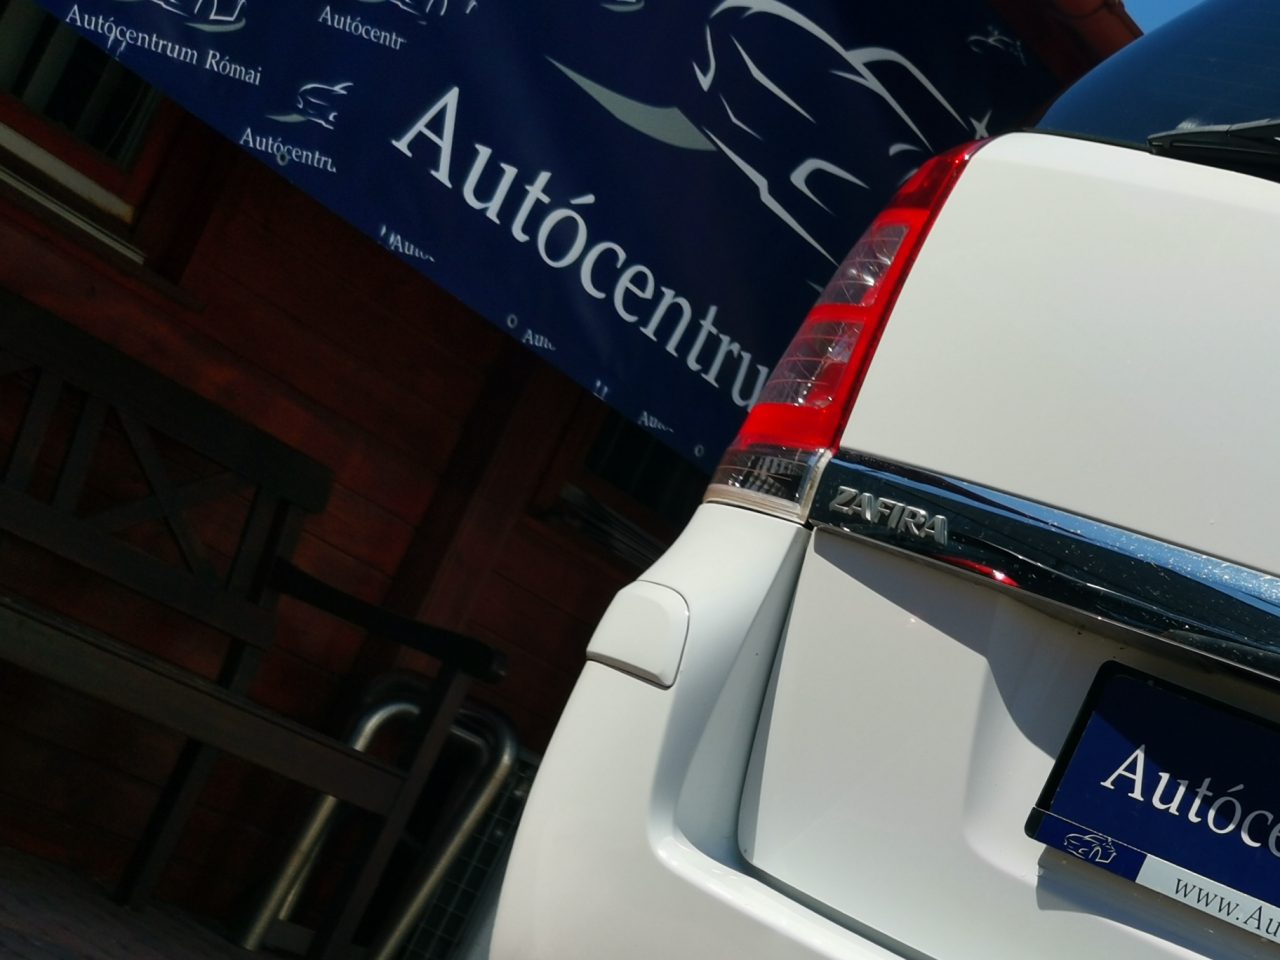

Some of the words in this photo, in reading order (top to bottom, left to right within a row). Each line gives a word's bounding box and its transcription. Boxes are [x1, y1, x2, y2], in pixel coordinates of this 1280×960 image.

[66, 4, 198, 65] Autócentrum
[206, 49, 262, 86] Római
[318, 5, 407, 50] Autócentr
[240, 127, 337, 173] Autócentru
[391, 86, 769, 414] Autócentru
[829, 485, 948, 546] ZAFIRA
